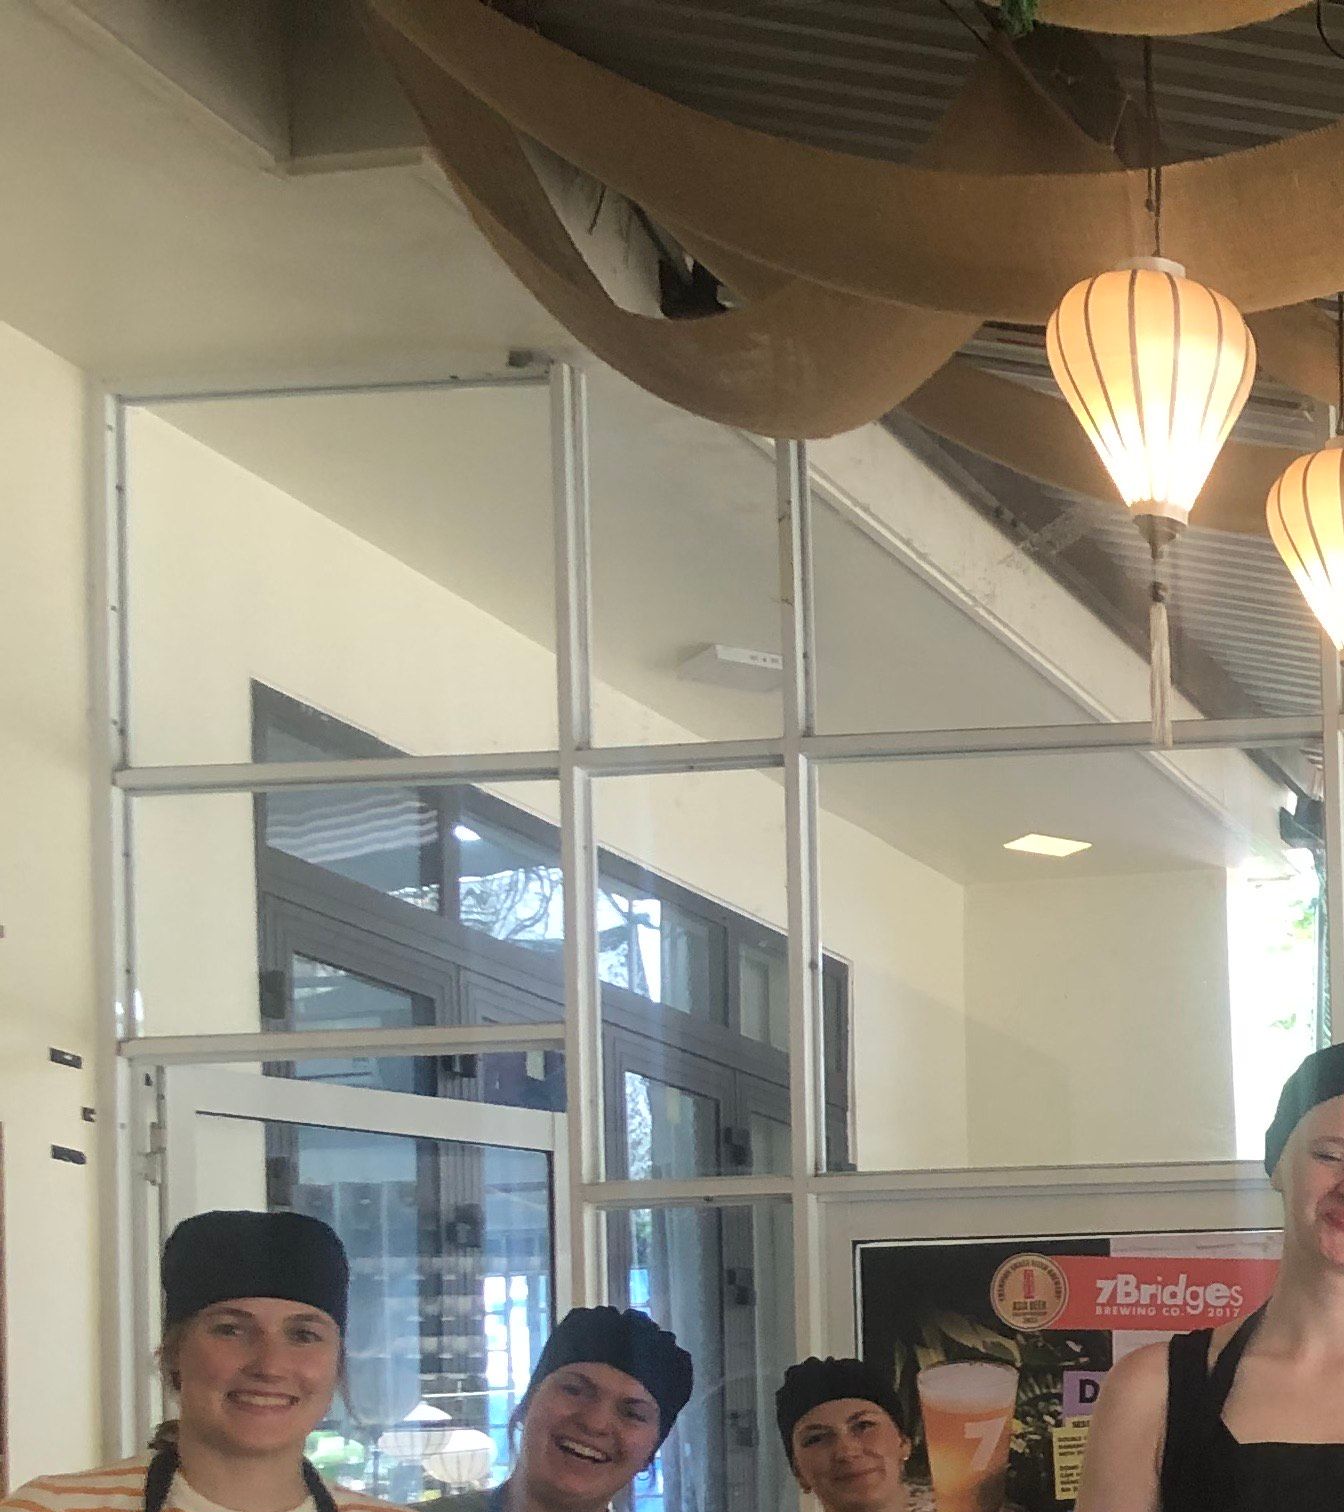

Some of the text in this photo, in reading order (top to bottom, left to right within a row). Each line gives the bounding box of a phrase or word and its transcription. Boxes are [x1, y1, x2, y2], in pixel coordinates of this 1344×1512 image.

[1095, 1272, 1244, 1316] 7Bridges
[1095, 1306, 1241, 1318] BREWING CO. 2017
[963, 1416, 1008, 1472] 7
